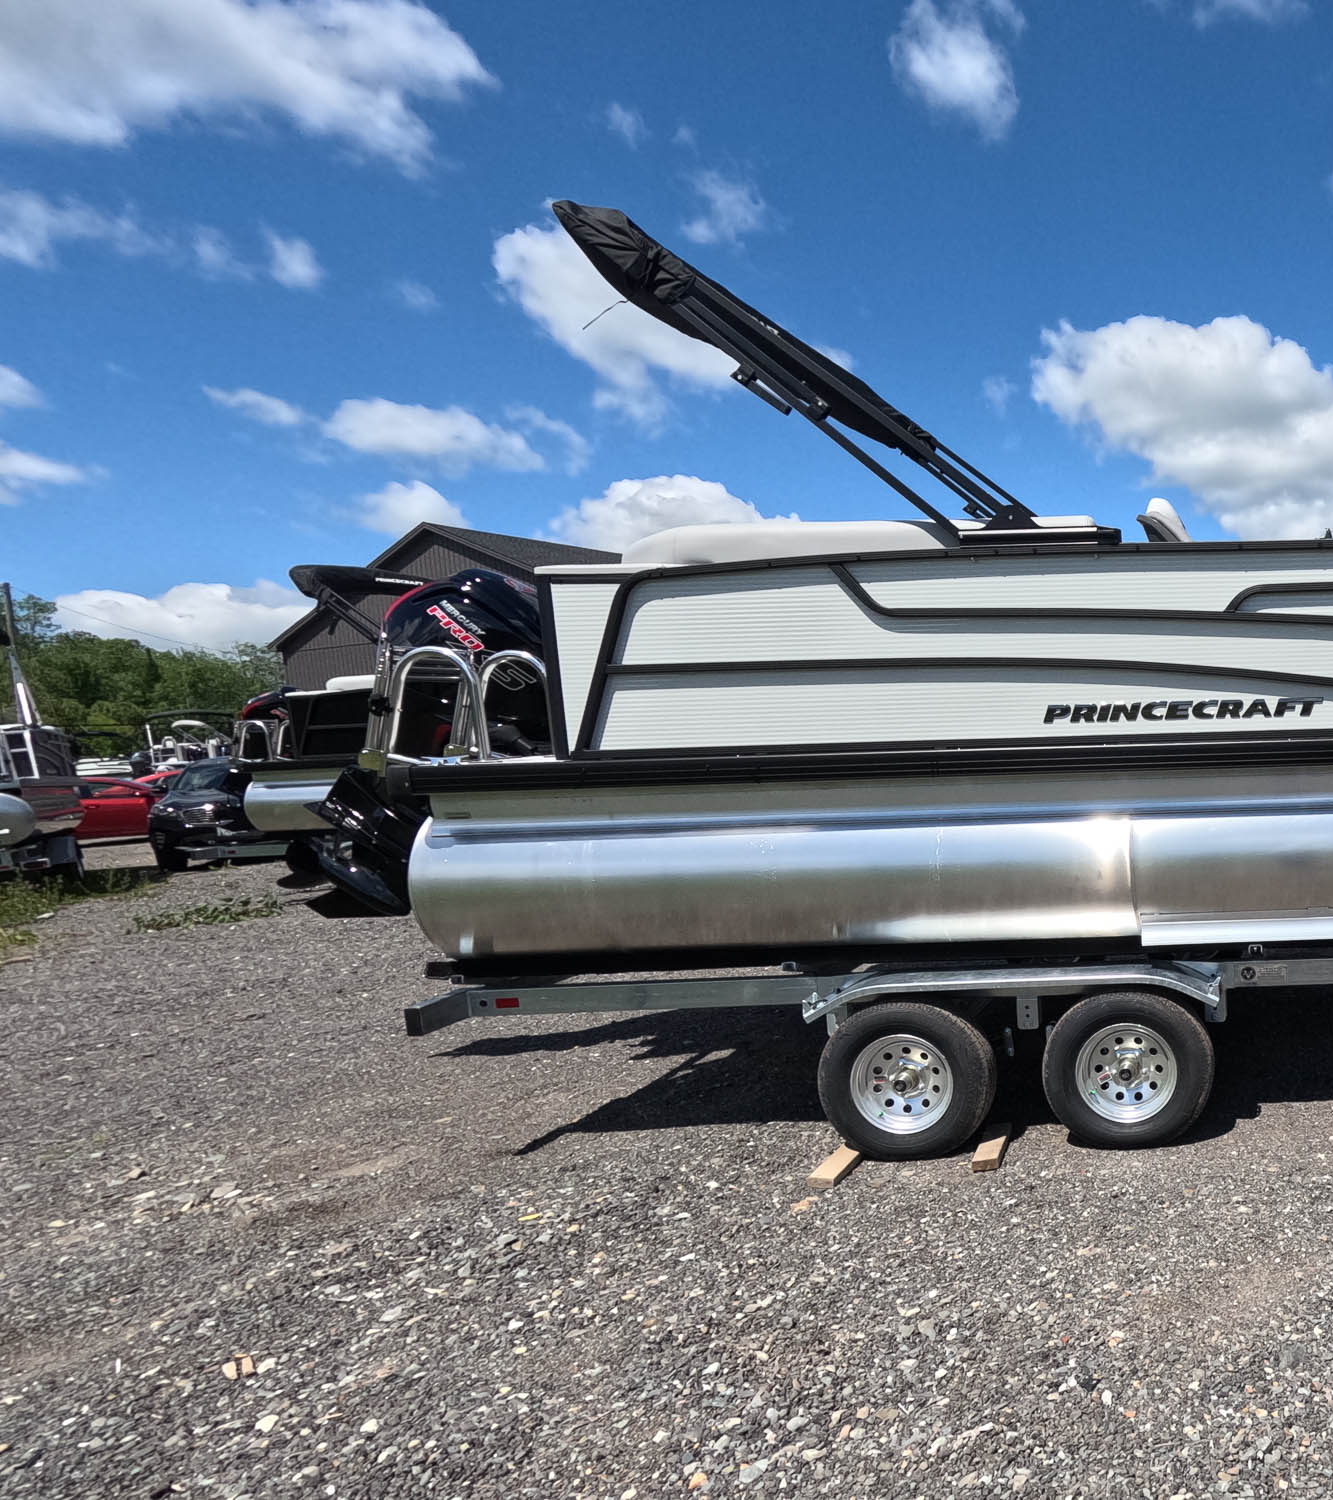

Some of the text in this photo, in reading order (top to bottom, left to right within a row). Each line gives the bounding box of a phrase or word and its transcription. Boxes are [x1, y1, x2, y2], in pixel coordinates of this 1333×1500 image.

[426, 604, 485, 651] PRO
[438, 599, 487, 636] MERCURY
[1043, 697, 1324, 725] PRINCECRAFT
